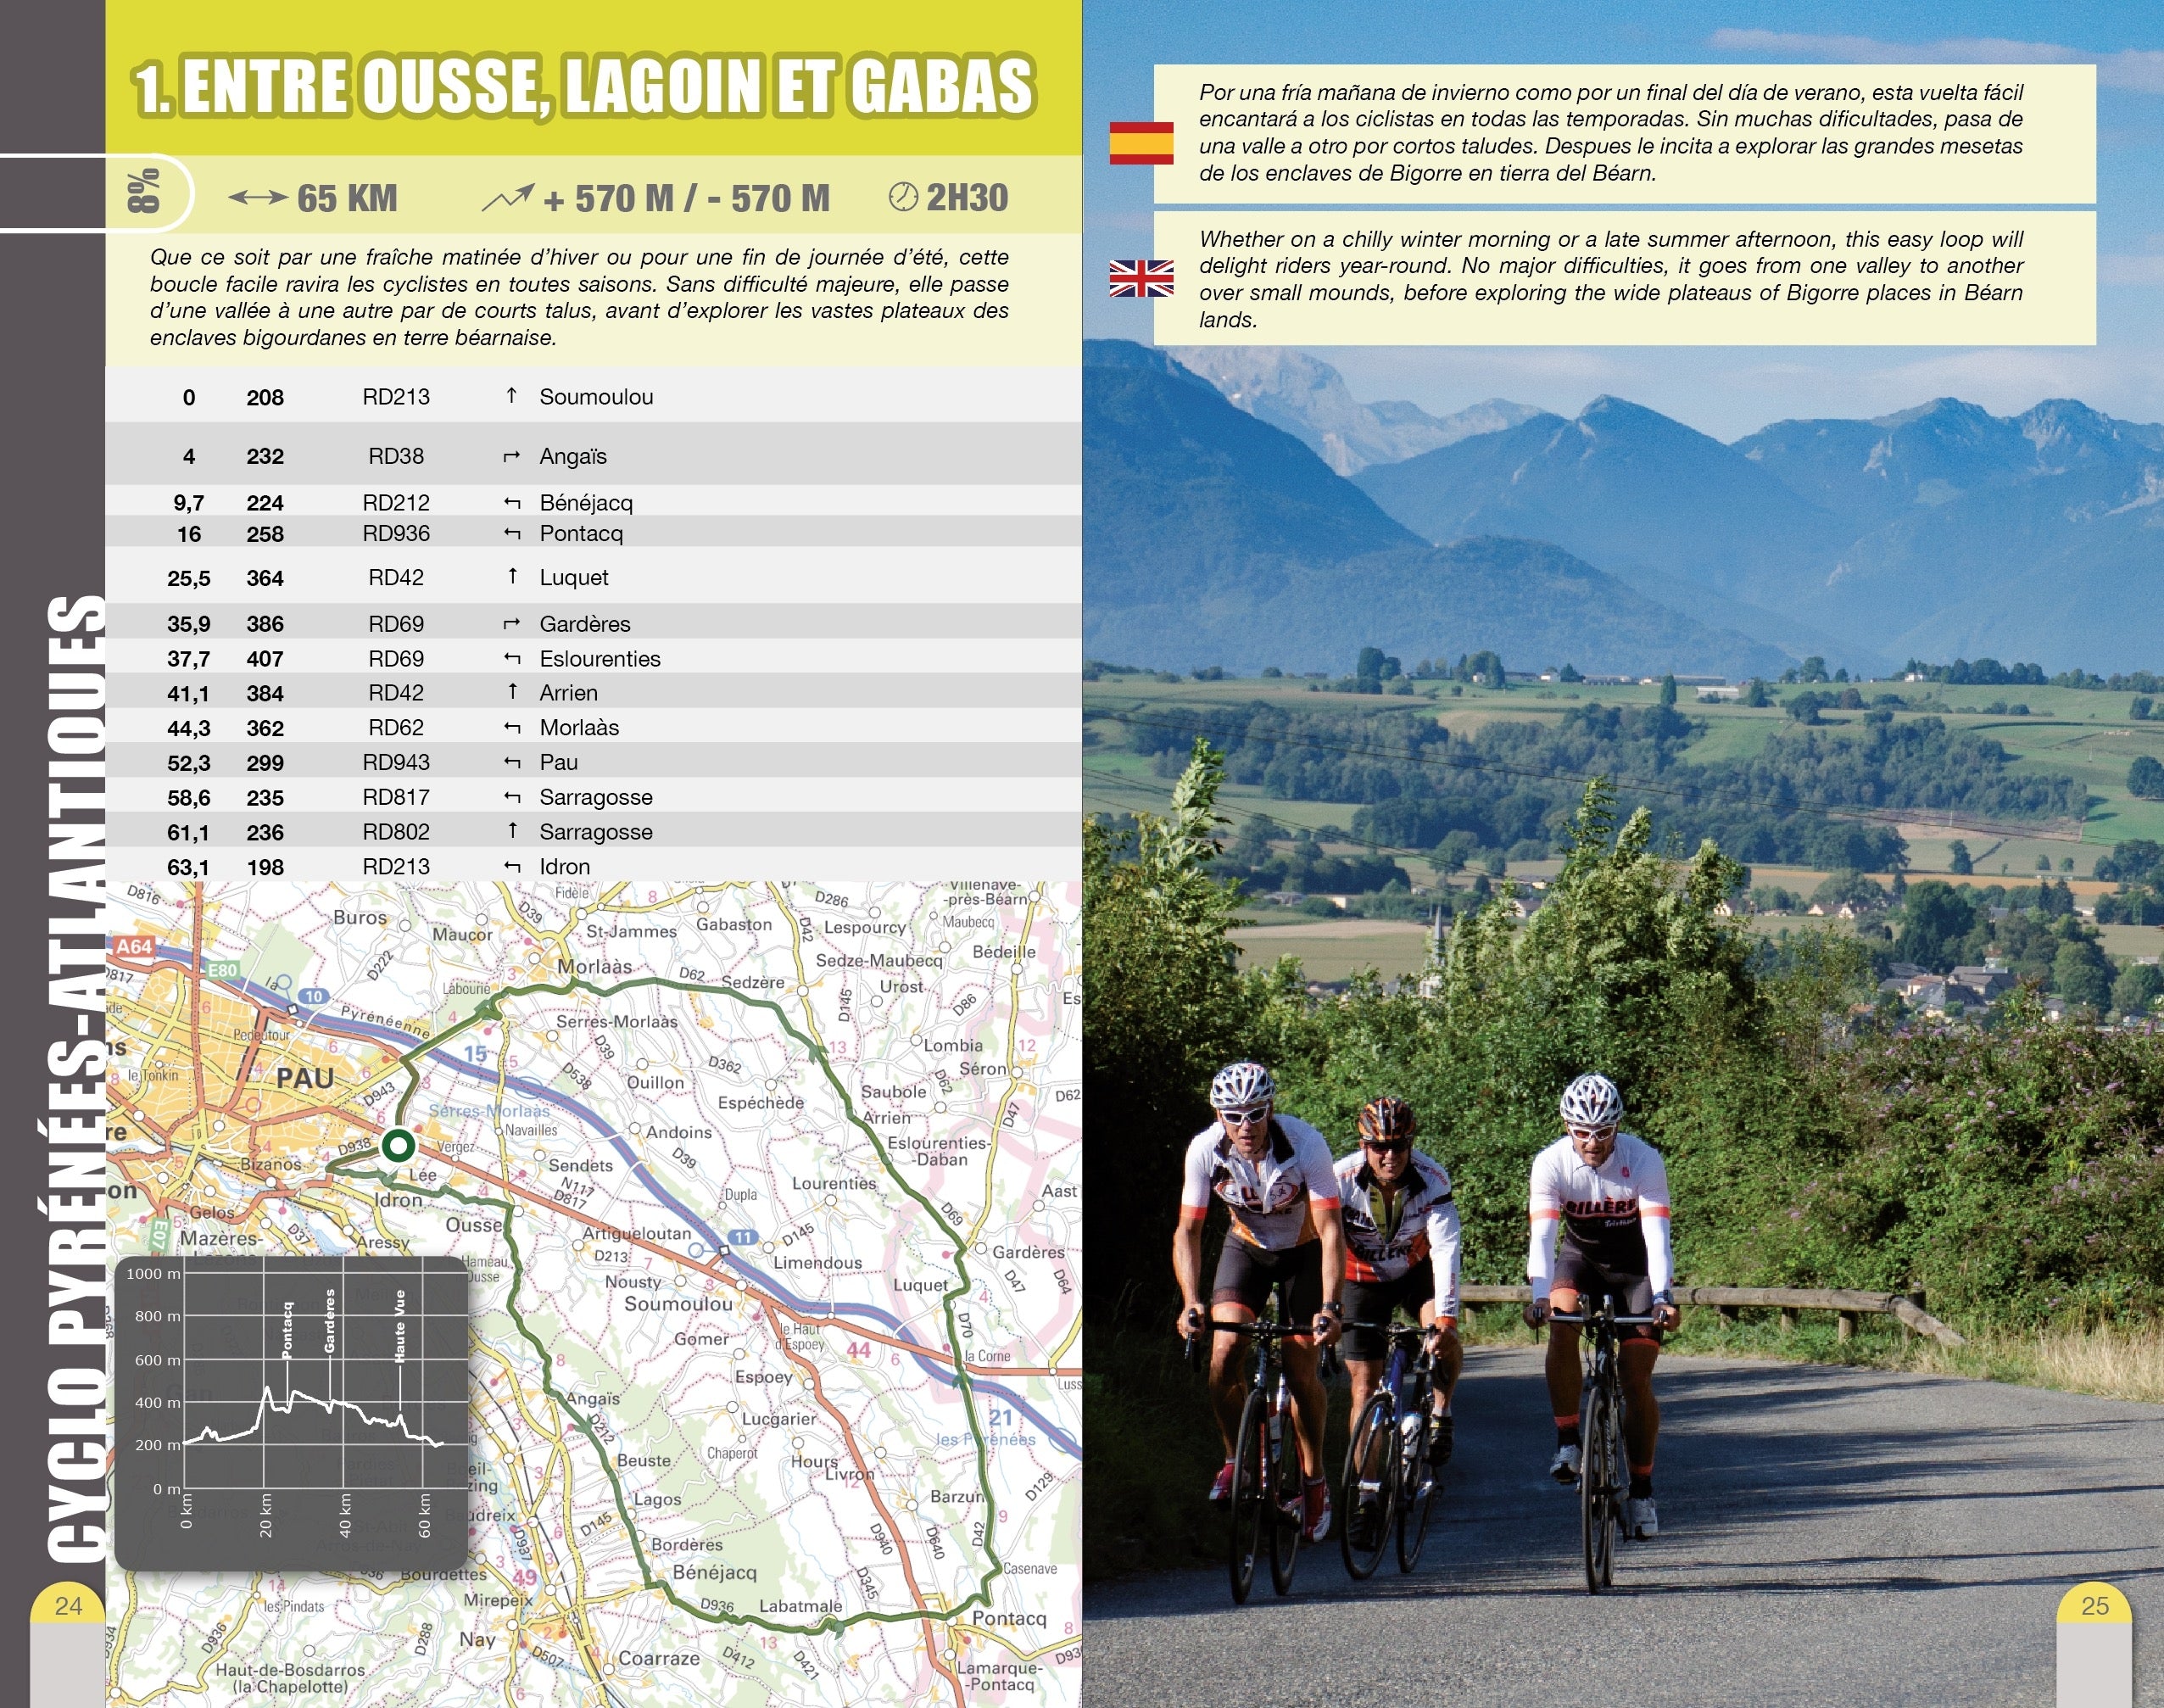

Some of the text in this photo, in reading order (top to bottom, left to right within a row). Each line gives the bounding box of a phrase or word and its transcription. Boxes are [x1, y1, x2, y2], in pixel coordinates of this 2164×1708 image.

[137, 59, 1032, 119] 1. ENTRE OUSSE, LAGOIN ET GABAS
[1200, 165, 1655, 185] de los enclaves de Bigorre en tierra del Béarn.
[128, 168, 159, 213] 8%
[298, 184, 396, 212] 65 KM
[577, 184, 634, 212] 570
[647, 184, 672, 211] M
[684, 183, 698, 212] /
[733, 184, 790, 212] 570
[803, 184, 828, 211] M
[928, 183, 1008, 212] 2H30
[1200, 257, 2025, 277] delight riders year-round. No major difficulties, it goes from one valley to another
[151, 329, 555, 349] enclaves bigourdanes en terre béarnaise.
[184, 388, 652, 405] 0 208 RD213 Soumoulou
[183, 448, 606, 469] 4 232 RD38 Angaïs
[175, 494, 632, 515] 9,7 224 RD212 Bénéjacq
[168, 569, 608, 589] 25,5 364 RD42 Luquet
[168, 684, 597, 705] 41,1 384 RD42 Arrien
[168, 858, 589, 879] 63,1 198 RD213 Idron
[334, 910, 387, 925] Buros
[519, 901, 543, 924] D39
[433, 929, 493, 941] Maucor
[587, 925, 677, 938] St-Jammes
[825, 921, 906, 936] Lespourcy
[115, 940, 152, 954] A64
[973, 945, 1036, 958] Bédeille
[366, 950, 394, 982] D222
[558, 959, 632, 974] Morlaàs
[816, 954, 943, 969] Sedze-Maubecq
[209, 964, 237, 977] E80
[443, 984, 491, 994] Labourie
[880, 980, 923, 993] Urost
[306, 991, 322, 1002] 10
[556, 1015, 678, 1028] Serres-Morlaàs
[924, 1039, 983, 1052] Lombia
[465, 1046, 487, 1061] 15
[960, 1061, 1007, 1075] Séron
[277, 1068, 334, 1089] PAU
[627, 1076, 684, 1089] Ouillon
[363, 1081, 396, 1107] D943
[862, 1085, 926, 1099] Saubole
[863, 1111, 911, 1125] Arrien
[646, 1126, 712, 1138] Andoins
[889, 1136, 991, 1149] Eslourenties-
[241, 1158, 302, 1170] Bizanos
[549, 1159, 613, 1172] Sendets
[794, 1177, 877, 1190] Lourenties
[1042, 1185, 1078, 1197] Aast
[375, 1192, 423, 1208] Idron
[446, 1218, 502, 1232] Ousse
[583, 1228, 691, 1241] Artigueloutan
[736, 1232, 750, 1243] 11
[594, 1250, 628, 1263] D213
[993, 1246, 1065, 1259] Gardères
[774, 1257, 862, 1270] Limendous
[128, 1269, 181, 1280] 1000 m
[605, 1275, 661, 1289] Nousty
[894, 1279, 949, 1294] Luquet
[625, 1297, 733, 1311] Soumoulou
[324, 1289, 335, 1354] Gardères
[394, 1290, 405, 1364] Haute Vue
[282, 1302, 294, 1359] Pontacq
[675, 1333, 728, 1346] Gomer
[136, 1355, 181, 1366] 600 m
[734, 1371, 793, 1386] Espoey
[566, 1393, 620, 1409] Angaïs
[618, 1454, 672, 1467] Beuste
[707, 1447, 758, 1461] Chaperot
[47, 1369, 106, 1563] CYCLO
[154, 1484, 181, 1495] 0 m
[931, 1490, 985, 1503] Barzun
[635, 1493, 682, 1509] Lagos
[181, 1493, 192, 1529] 0 km
[260, 1493, 271, 1538] 20 km
[419, 1493, 430, 1538] 60 km
[652, 1538, 723, 1551] Bordères
[673, 1565, 757, 1582] Bénéjacq
[1003, 1563, 1057, 1574] Casenave
[512, 1571, 537, 1586] 49
[55, 1597, 83, 1616] 24
[464, 1594, 533, 1610] Mirepeix
[760, 1600, 843, 1612] Labatmale
[2082, 1596, 2110, 1616] 25
[973, 1610, 1047, 1629] Pontacq
[201, 1621, 228, 1655] D936
[460, 1632, 495, 1649] Nay
[619, 1651, 700, 1666] Coarraze
[216, 1663, 365, 1677] Haut-de-Bosdarros
[233, 1680, 349, 1695] (la Chapelotte)
